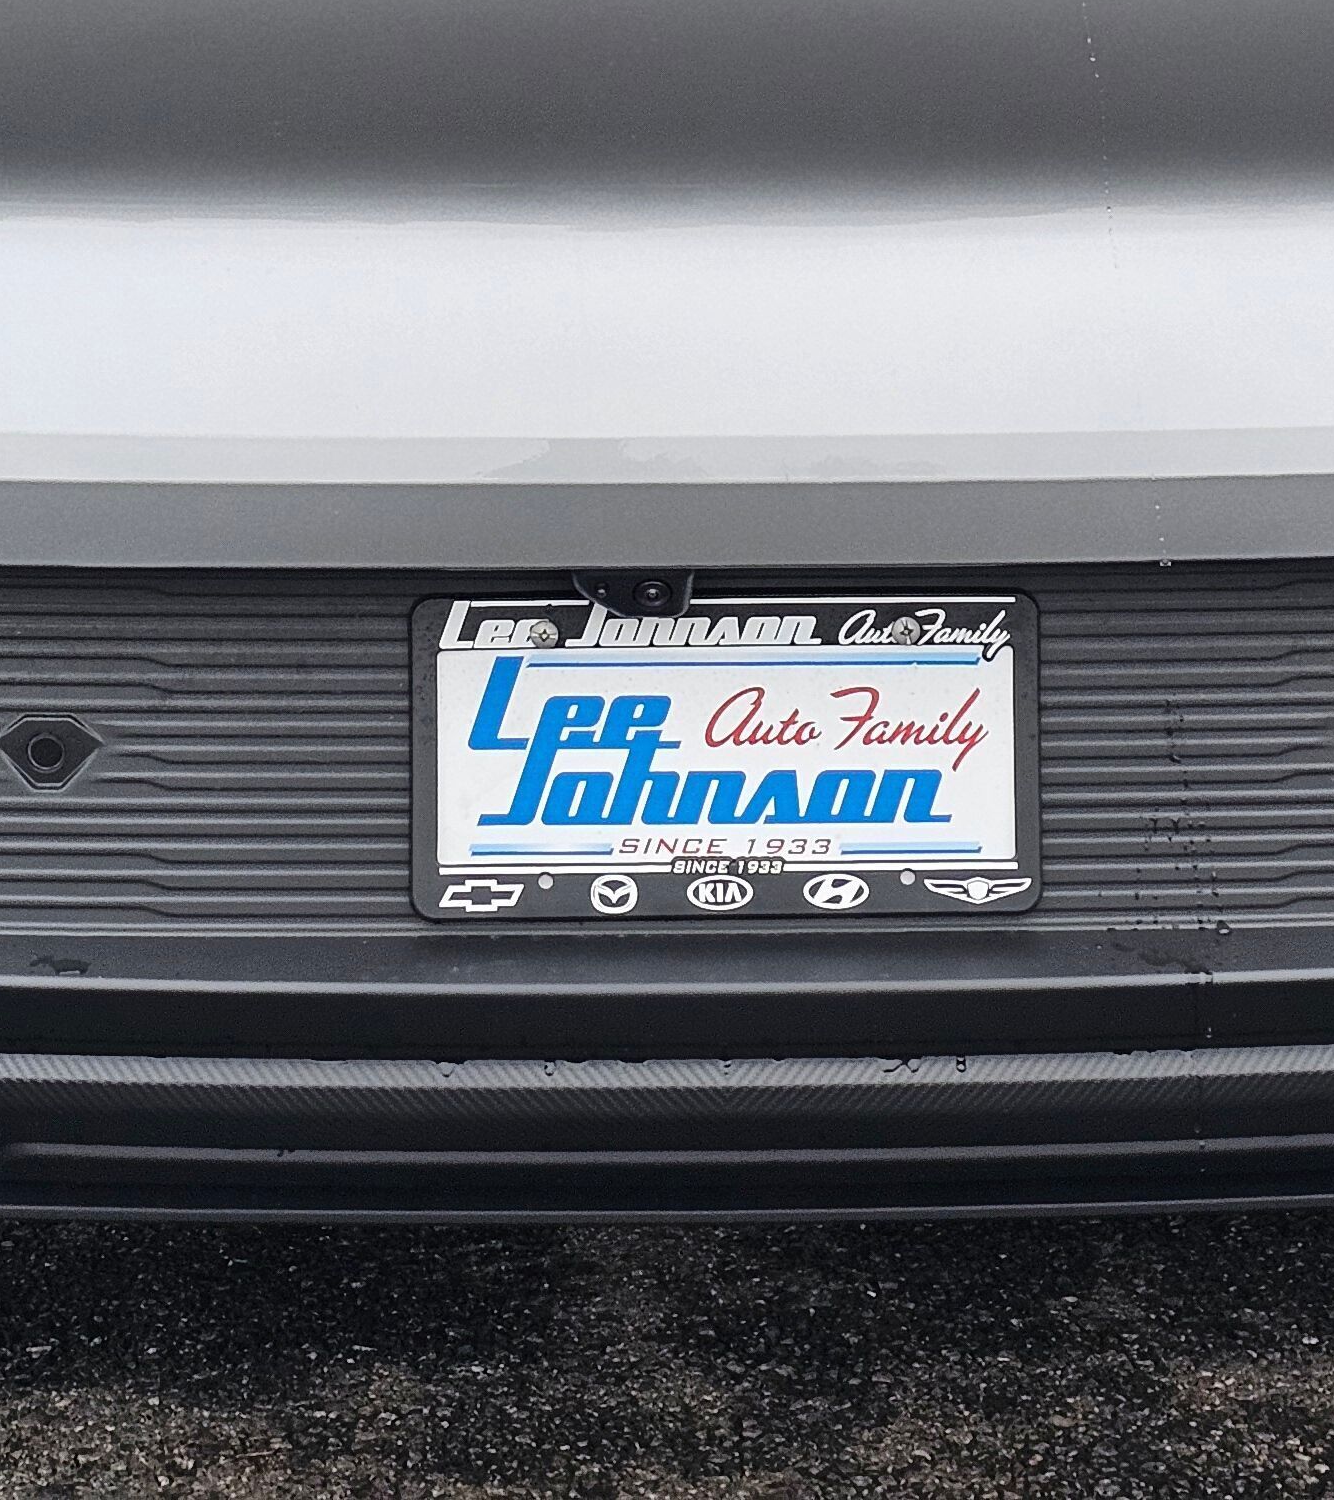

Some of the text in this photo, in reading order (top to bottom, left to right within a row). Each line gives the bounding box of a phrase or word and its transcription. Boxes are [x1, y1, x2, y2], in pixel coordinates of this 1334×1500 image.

[914, 608, 1011, 659] Family
[468, 656, 681, 750] Lee
[704, 687, 990, 772] Auto Family
[477, 739, 953, 826] Johnson
[618, 838, 832, 856] SINCE 1933
[672, 860, 783, 874] SINCE 1933
[698, 882, 743, 903] KIA
